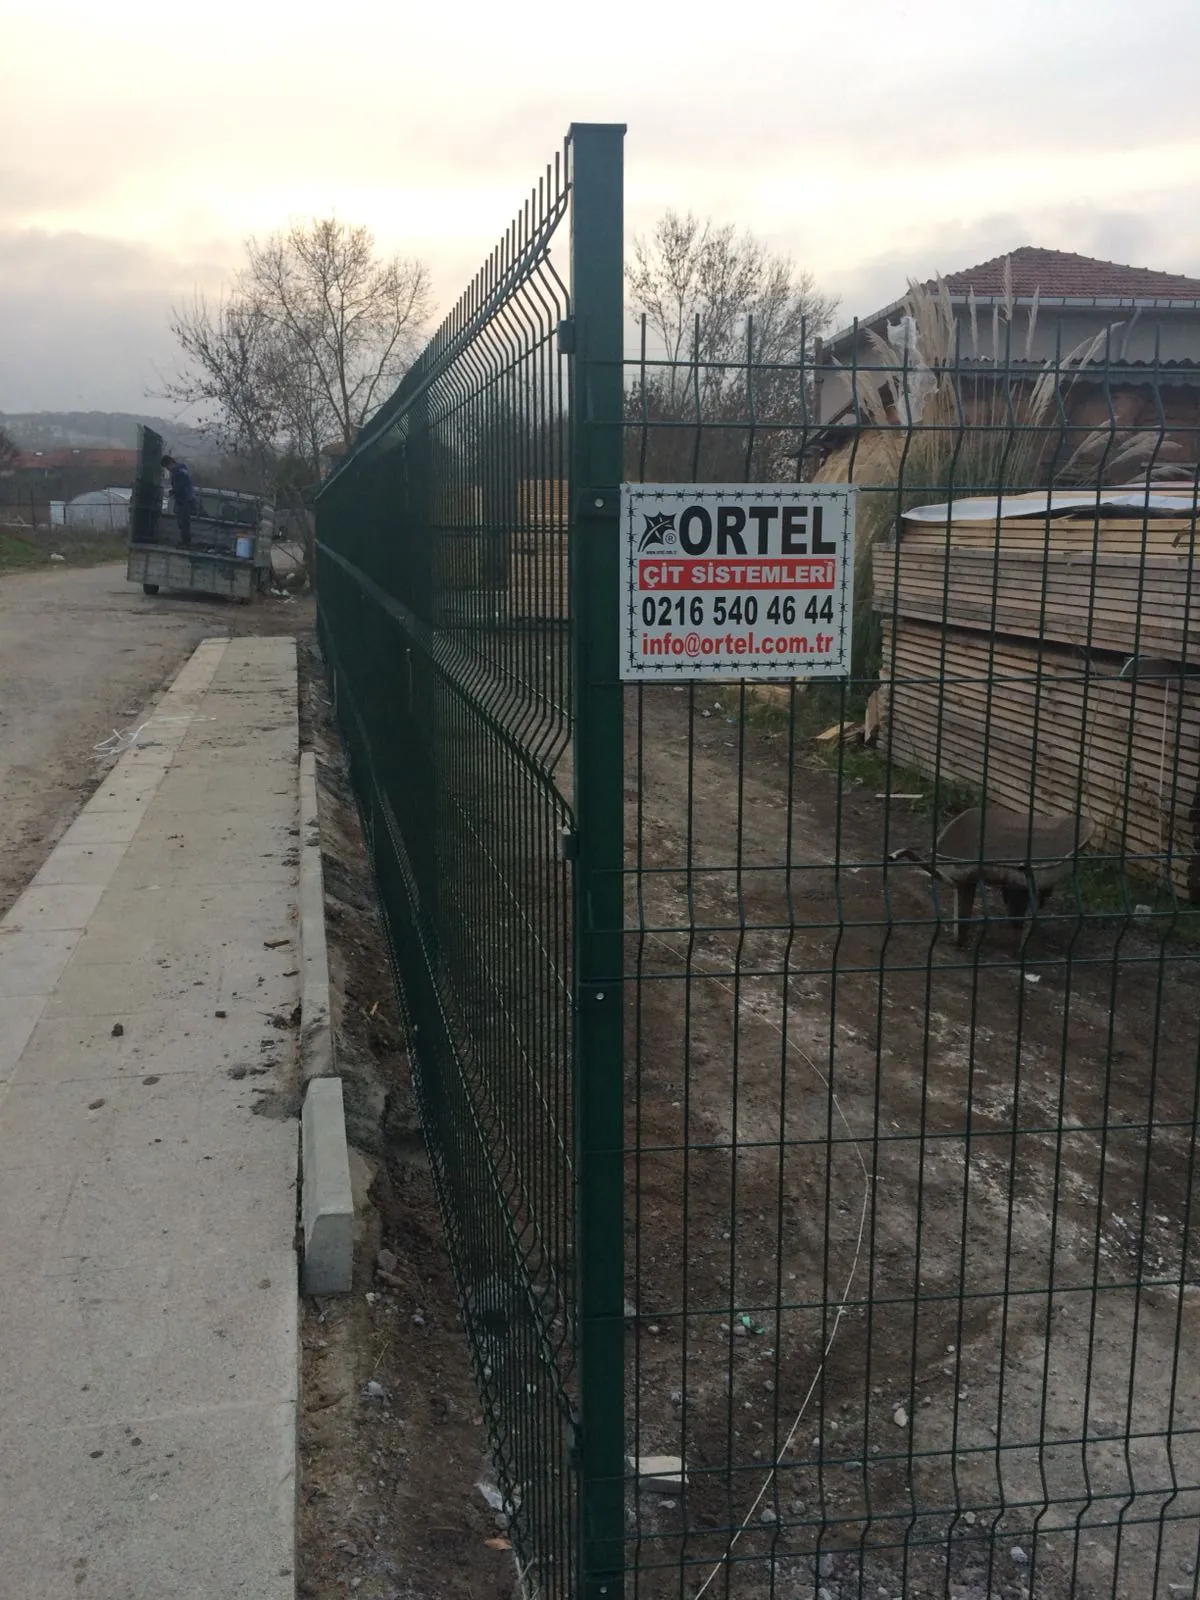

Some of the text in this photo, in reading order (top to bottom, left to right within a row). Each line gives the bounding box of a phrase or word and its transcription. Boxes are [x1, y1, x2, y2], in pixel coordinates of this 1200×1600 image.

[679, 505, 836, 556] ORTEL
[643, 561, 834, 588] ÇİT SİSTEMLERİ
[642, 595, 834, 626] 0216 540 46 44
[642, 632, 834, 657] info@ortel.com.tr
